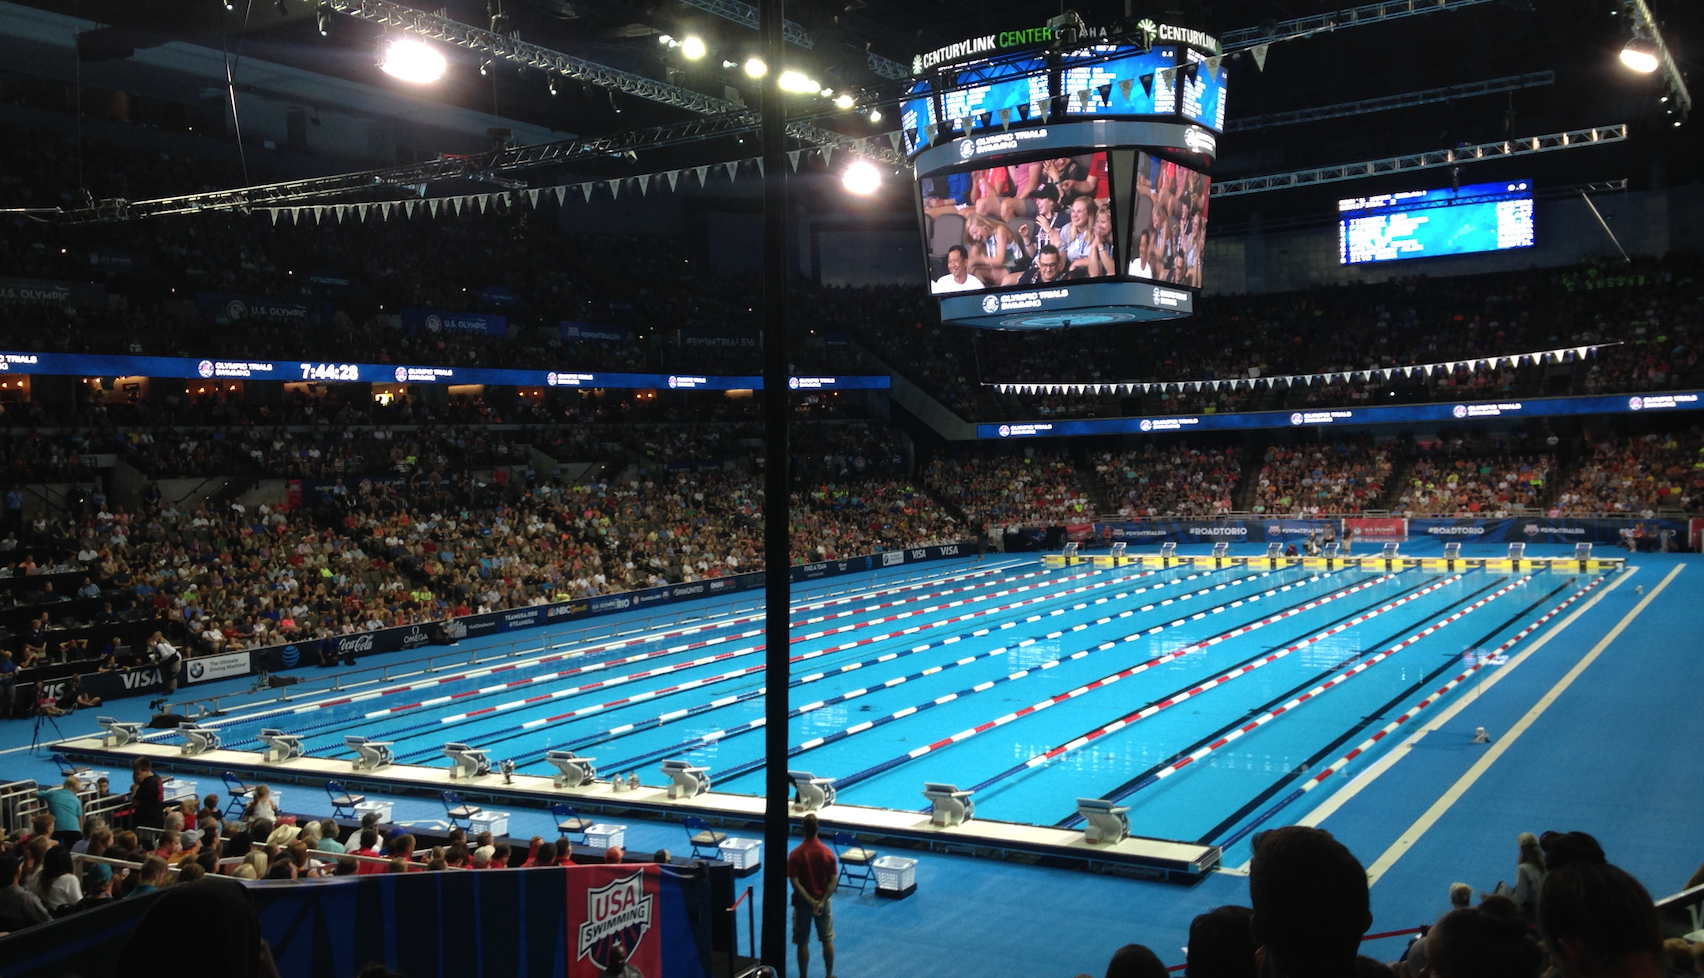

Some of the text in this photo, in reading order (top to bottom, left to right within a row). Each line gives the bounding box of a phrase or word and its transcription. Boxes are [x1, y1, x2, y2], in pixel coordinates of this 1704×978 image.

[1160, 24, 1216, 52] CENTURYLINK
[923, 35, 996, 69] CENTURYLINK
[1000, 27, 1052, 48] CENTER
[1015, 129, 1047, 140] TRIALS
[1039, 289, 1068, 299] TRIALS
[6, 355, 37, 364] TRIALS
[249, 363, 272, 371] TRIALS
[301, 363, 358, 380] 7:44:28
[1190, 527, 1247, 535] #ROADTORIO
[1428, 526, 1484, 535] #ROADTORIO
[912, 549, 927, 559] VISA
[940, 545, 959, 556] VISA
[617, 599, 630, 609] RIO
[556, 605, 571, 615] NBC
[404, 633, 429, 643] OMEGA
[219, 658, 239, 666] Ultimate
[119, 669, 163, 690] VISA
[596, 885, 635, 922] USA
[586, 905, 645, 943] SWIMMING
